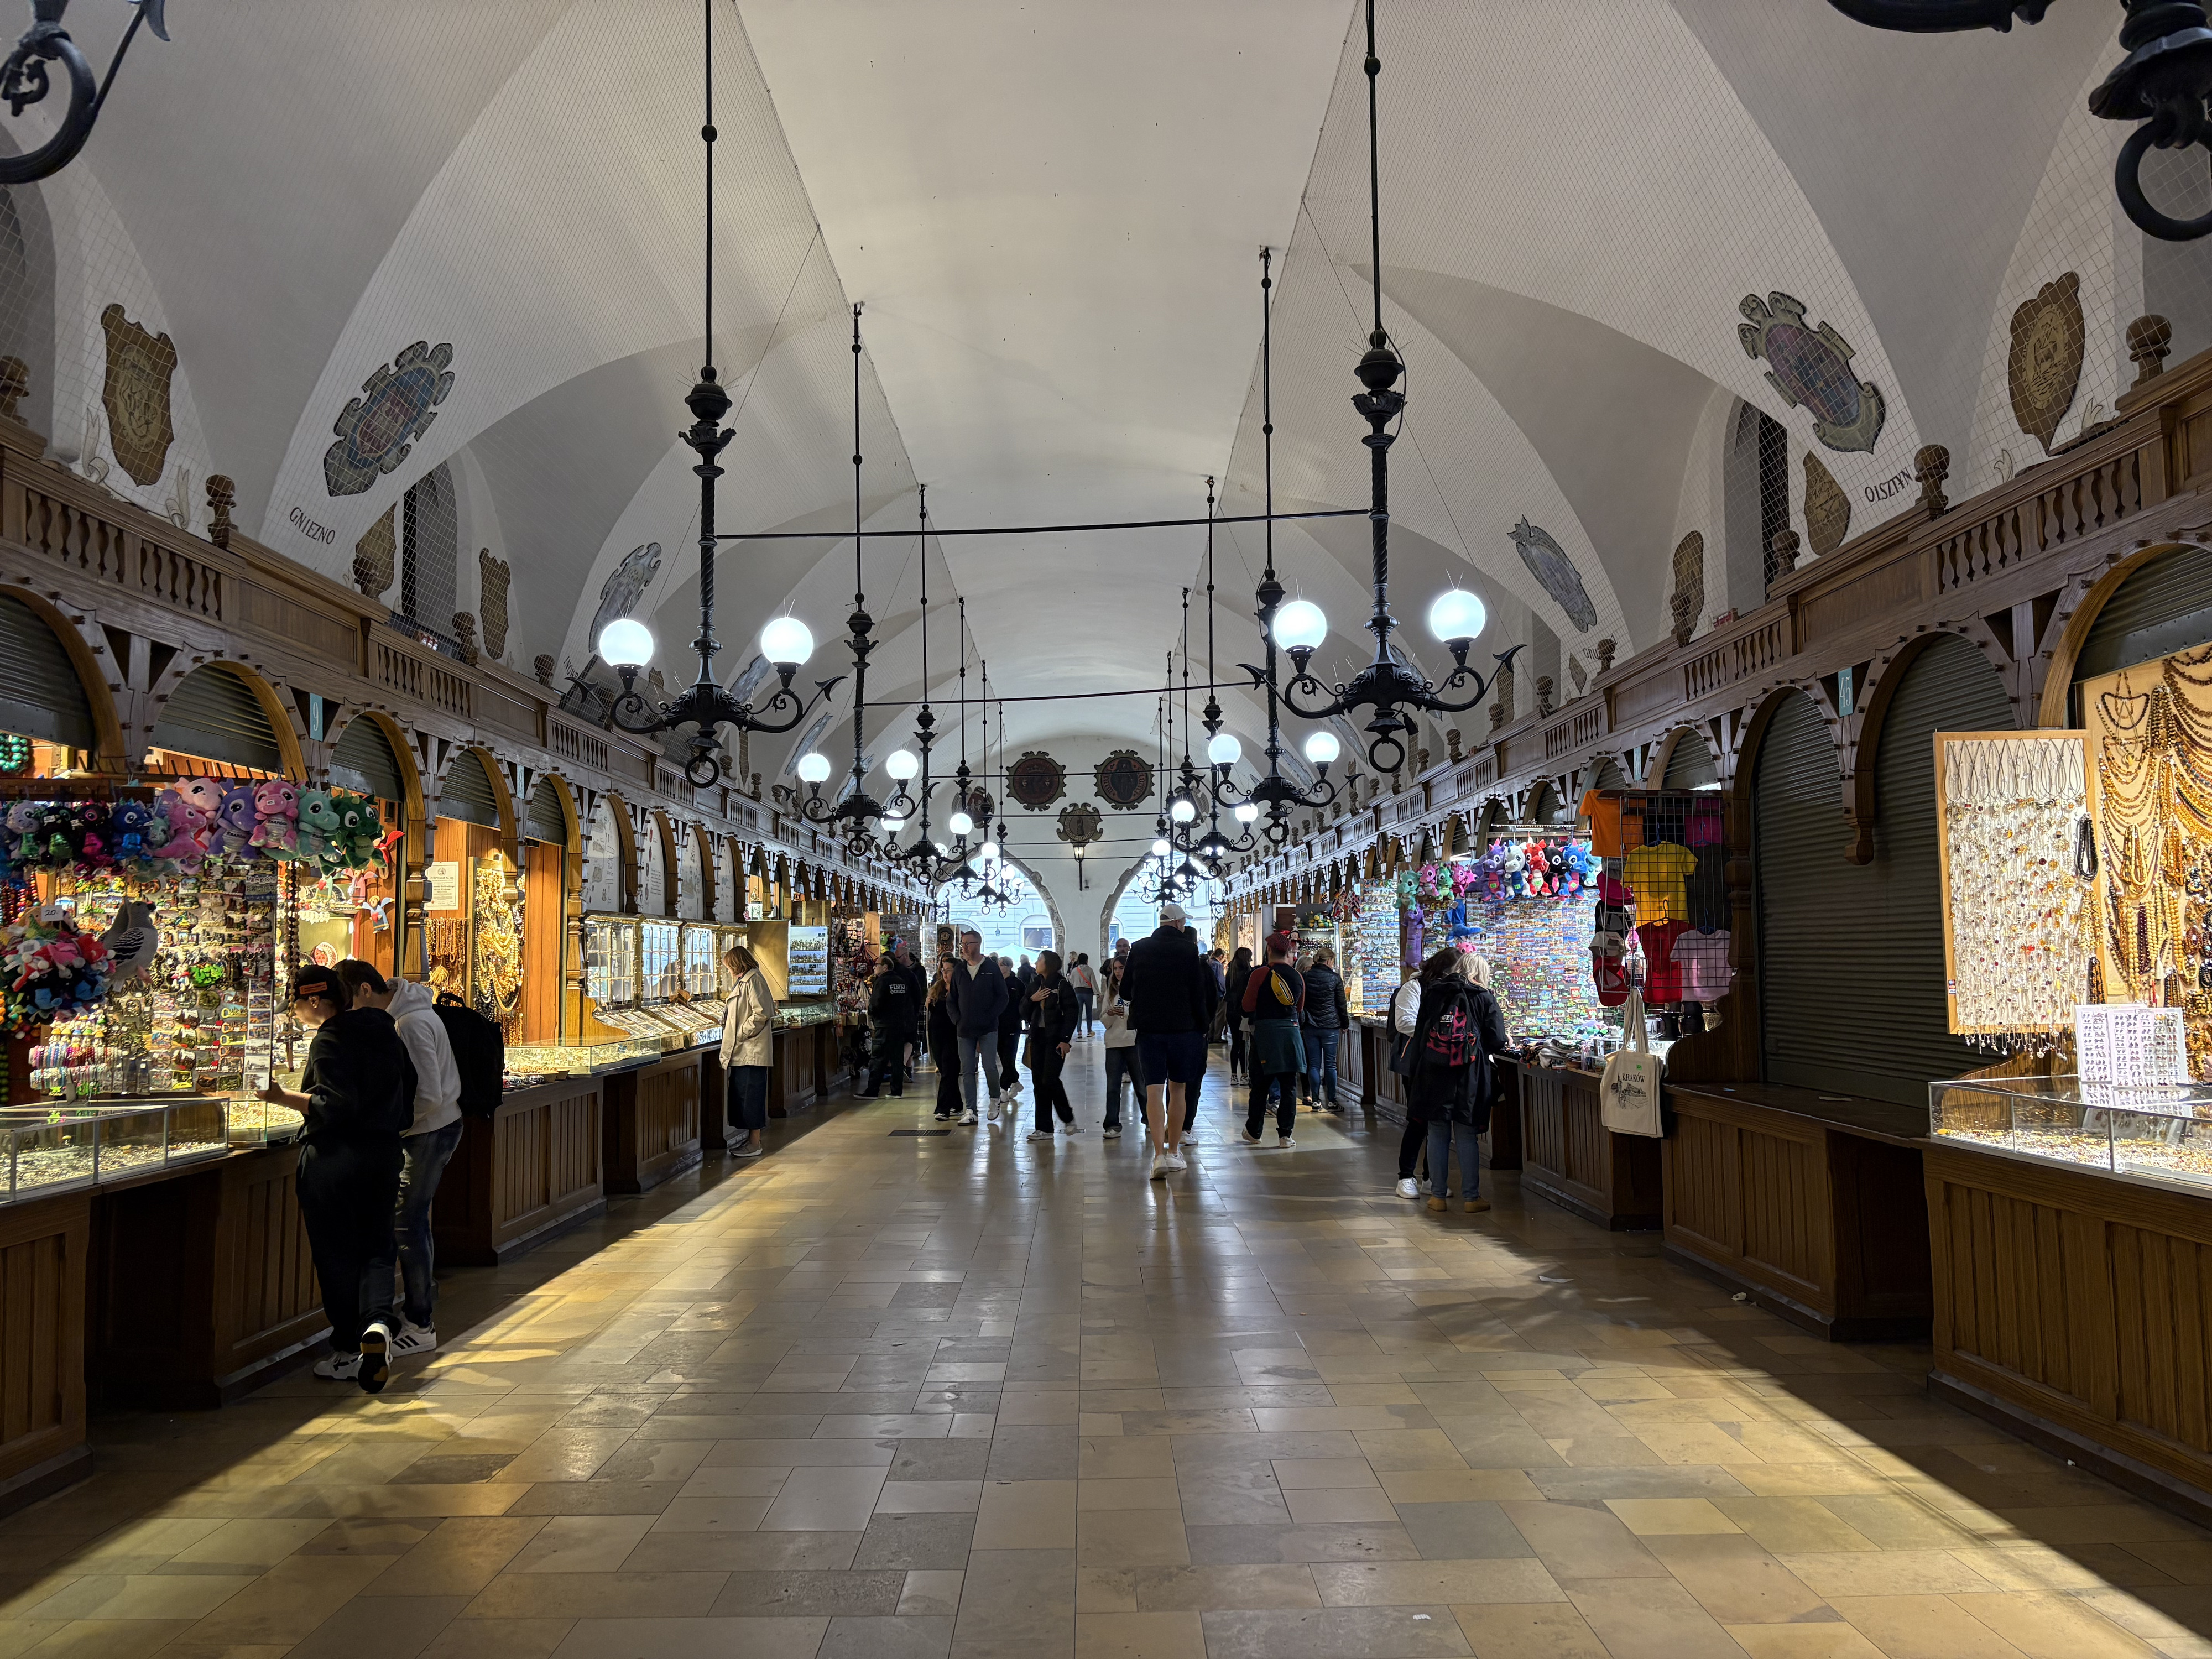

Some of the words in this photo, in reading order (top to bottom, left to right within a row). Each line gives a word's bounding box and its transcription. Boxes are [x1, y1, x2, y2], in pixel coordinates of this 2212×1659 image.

[1865, 467, 1913, 502] OLSZTYN
[290, 507, 335, 545] GNIEZNO
[1839, 676, 1851, 707] 45
[313, 702, 319, 731] 9
[1622, 1072, 1645, 1083] KRAKÓW
